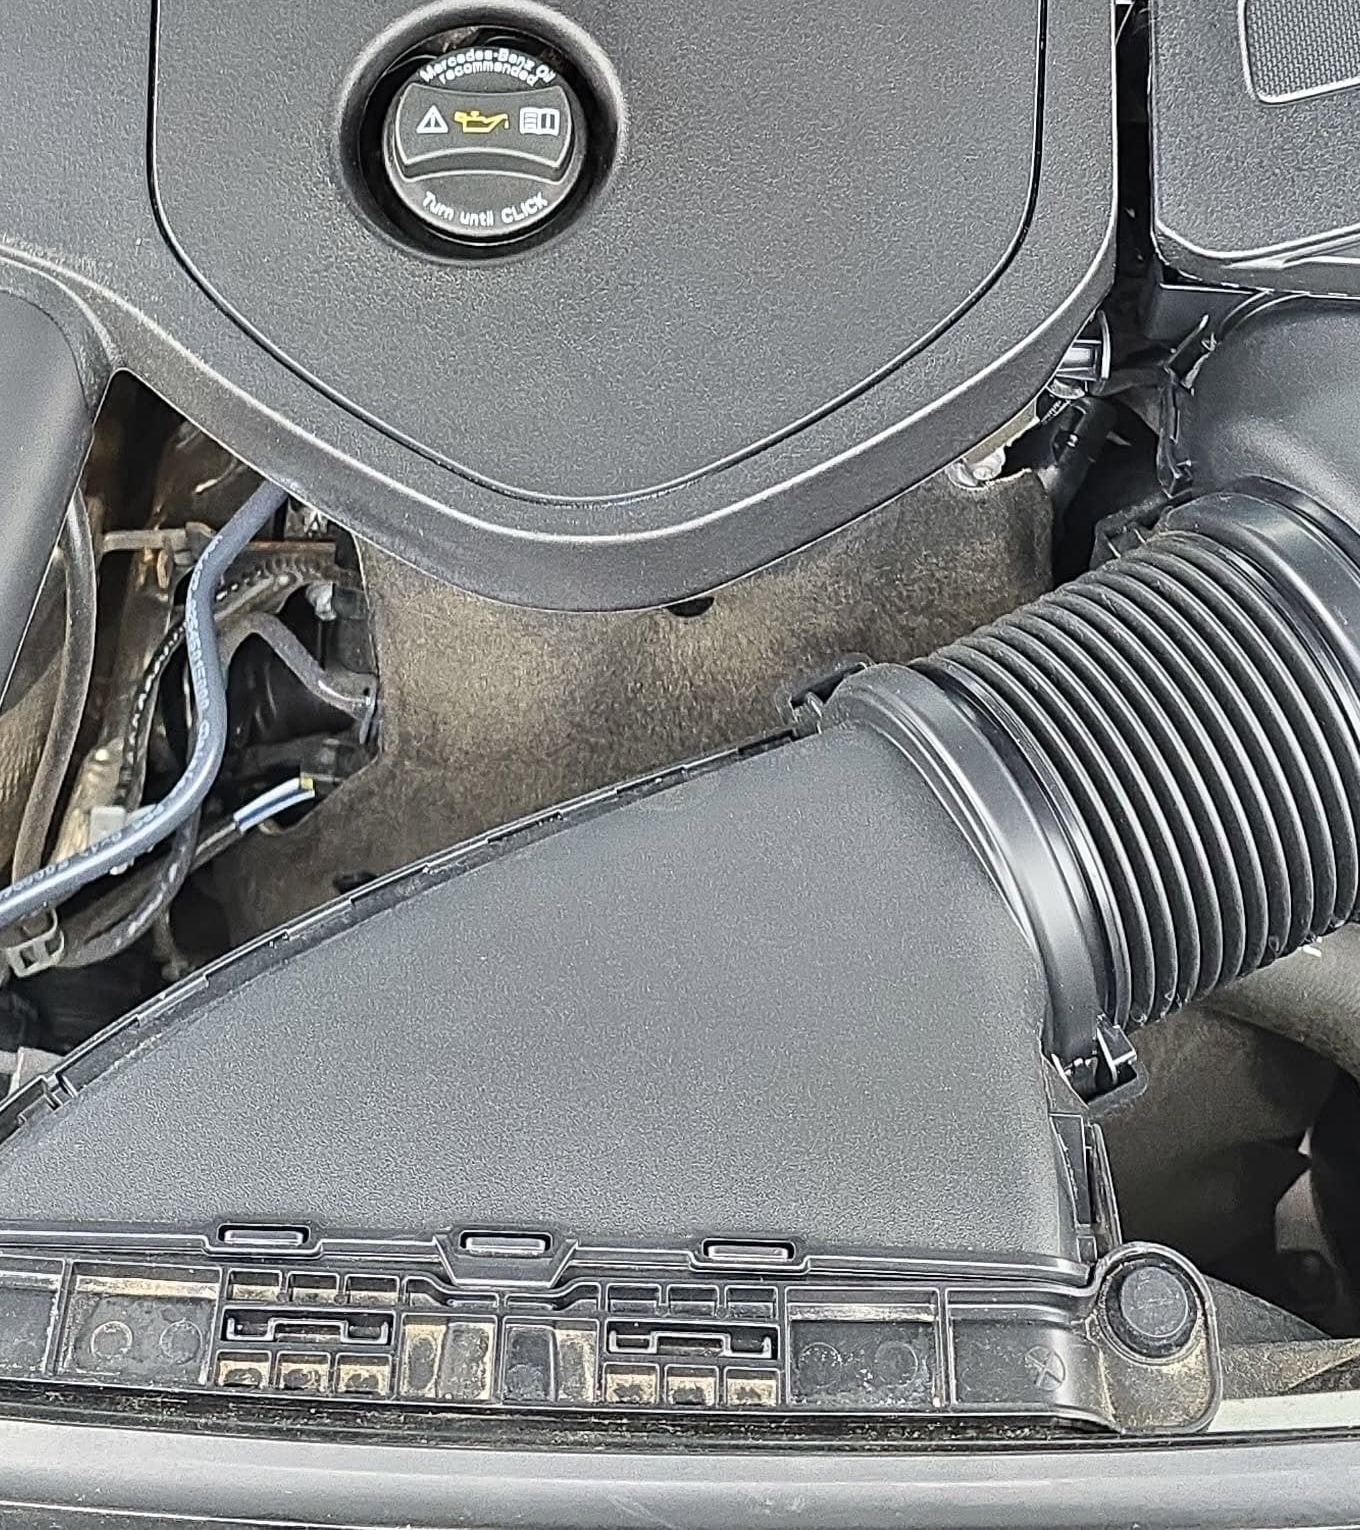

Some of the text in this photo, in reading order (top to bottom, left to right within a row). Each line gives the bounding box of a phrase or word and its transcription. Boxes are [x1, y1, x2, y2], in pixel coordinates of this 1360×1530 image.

[419, 48, 557, 83] Mercedes-Benz Oil
[439, 60, 538, 87] recommended
[422, 190, 549, 227] Turn until CLICK
